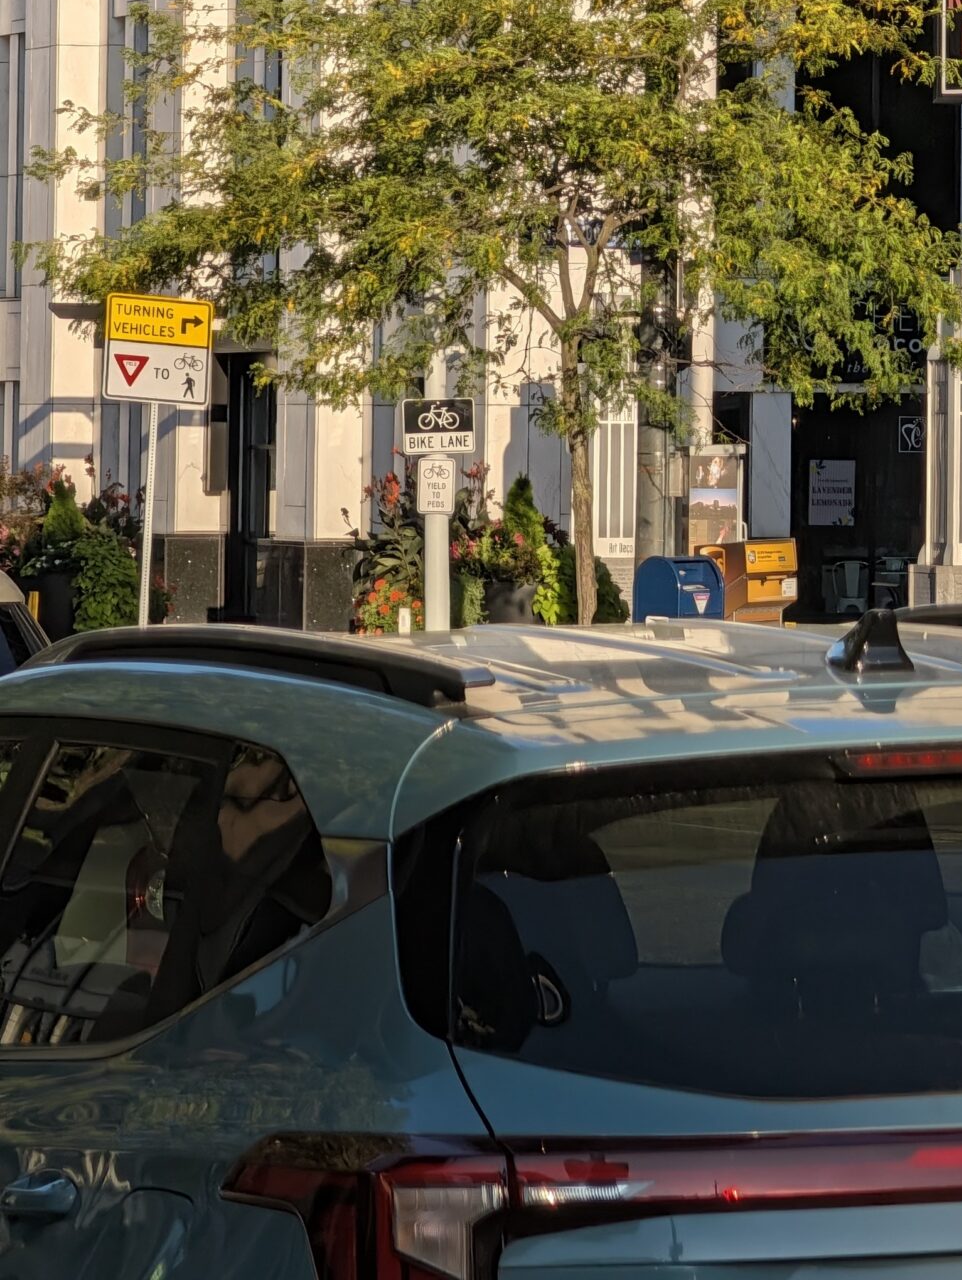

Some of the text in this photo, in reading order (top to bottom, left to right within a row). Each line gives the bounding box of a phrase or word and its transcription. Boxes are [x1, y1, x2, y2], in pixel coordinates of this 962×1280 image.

[116, 303, 175, 320] TURNING
[113, 321, 175, 339] VEHICLES
[154, 367, 171, 380] TO
[409, 434, 470, 450] BIKE LANE
[427, 482, 447, 490] YIELD
[432, 491, 441, 499] TO
[427, 500, 445, 509] PEDS
[608, 542, 618, 553] Art
